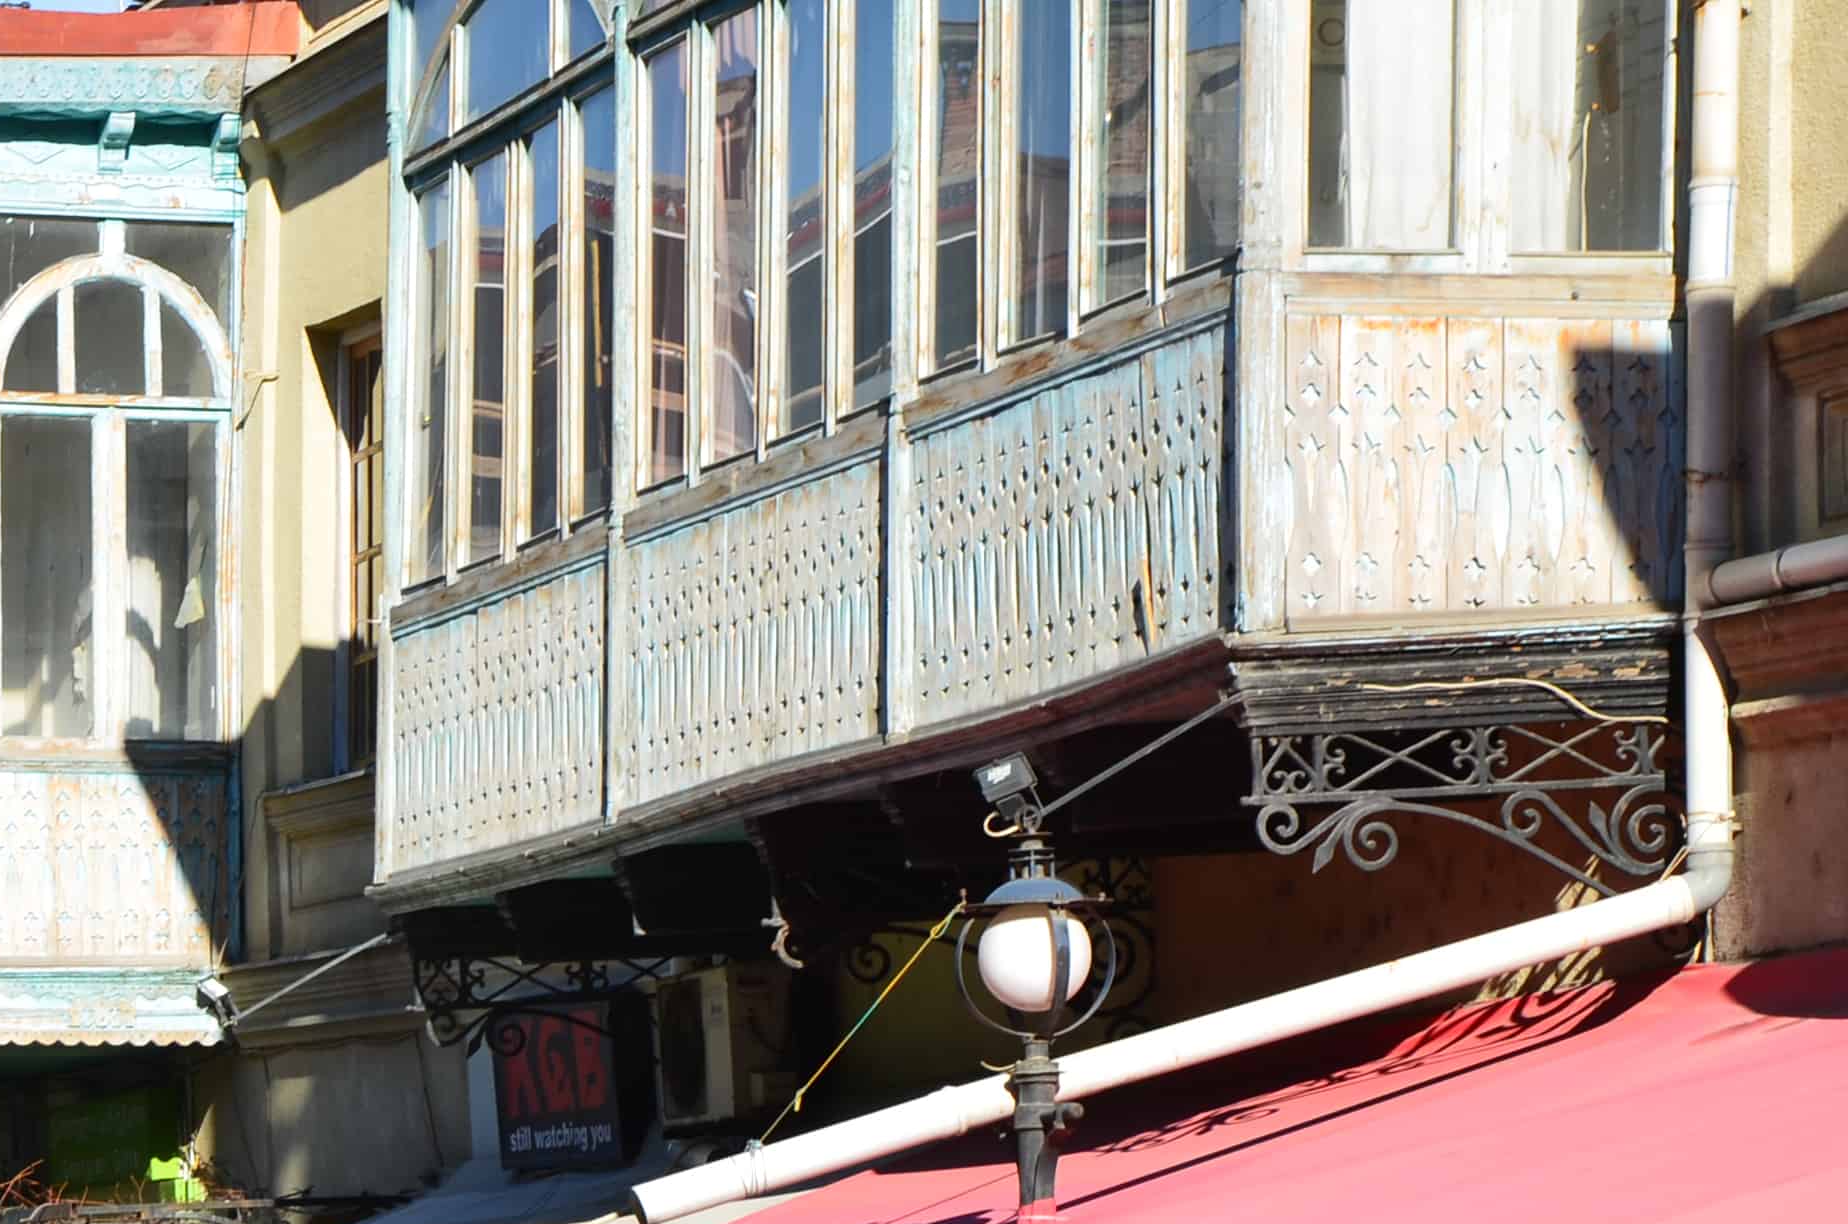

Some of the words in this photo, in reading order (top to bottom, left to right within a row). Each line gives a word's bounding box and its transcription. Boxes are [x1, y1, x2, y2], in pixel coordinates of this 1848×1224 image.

[509, 1125, 532, 1153] still
[534, 1121, 588, 1151] watching
[590, 1122, 612, 1151] you
